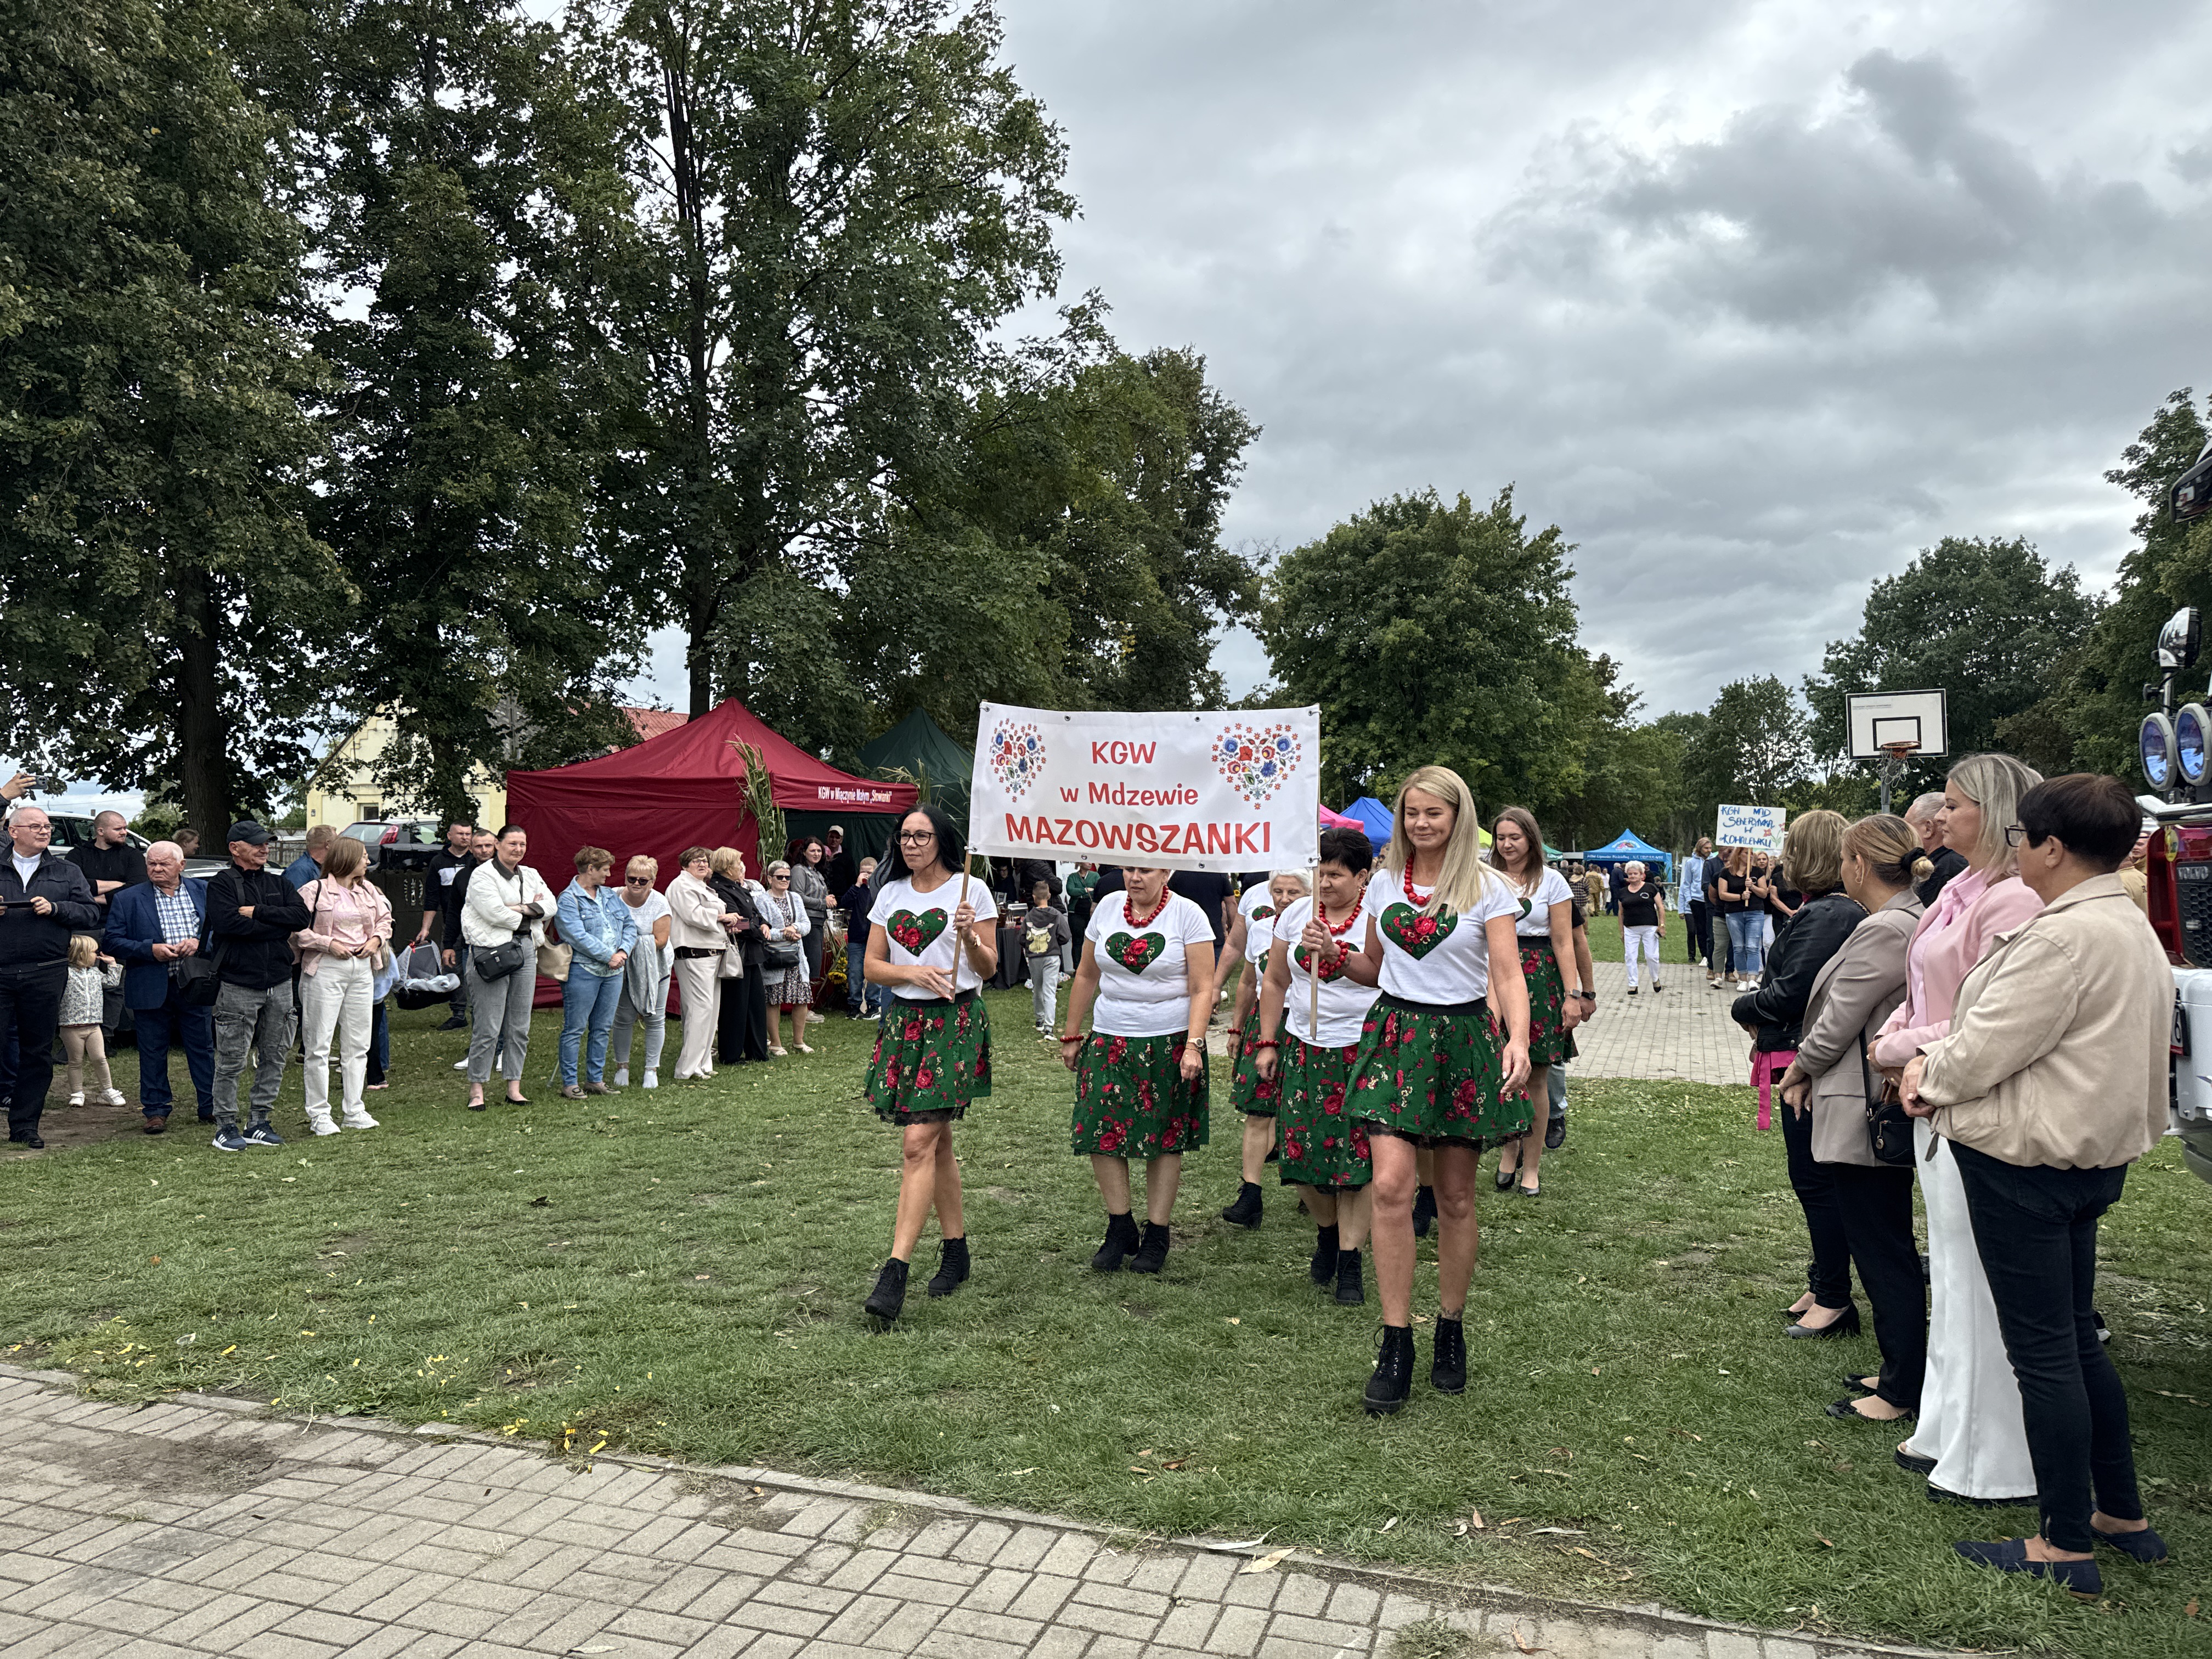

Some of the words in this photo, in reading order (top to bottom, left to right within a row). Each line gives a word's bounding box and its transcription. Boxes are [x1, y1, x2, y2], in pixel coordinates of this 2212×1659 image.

[1092, 741, 1156, 764] KGW
[818, 786, 830, 799] KGW
[831, 790, 834, 799] w
[1060, 787, 1079, 803] w
[1088, 782, 1199, 806] Mdzewie
[1006, 812, 1271, 855] MAZOWSZANKI
